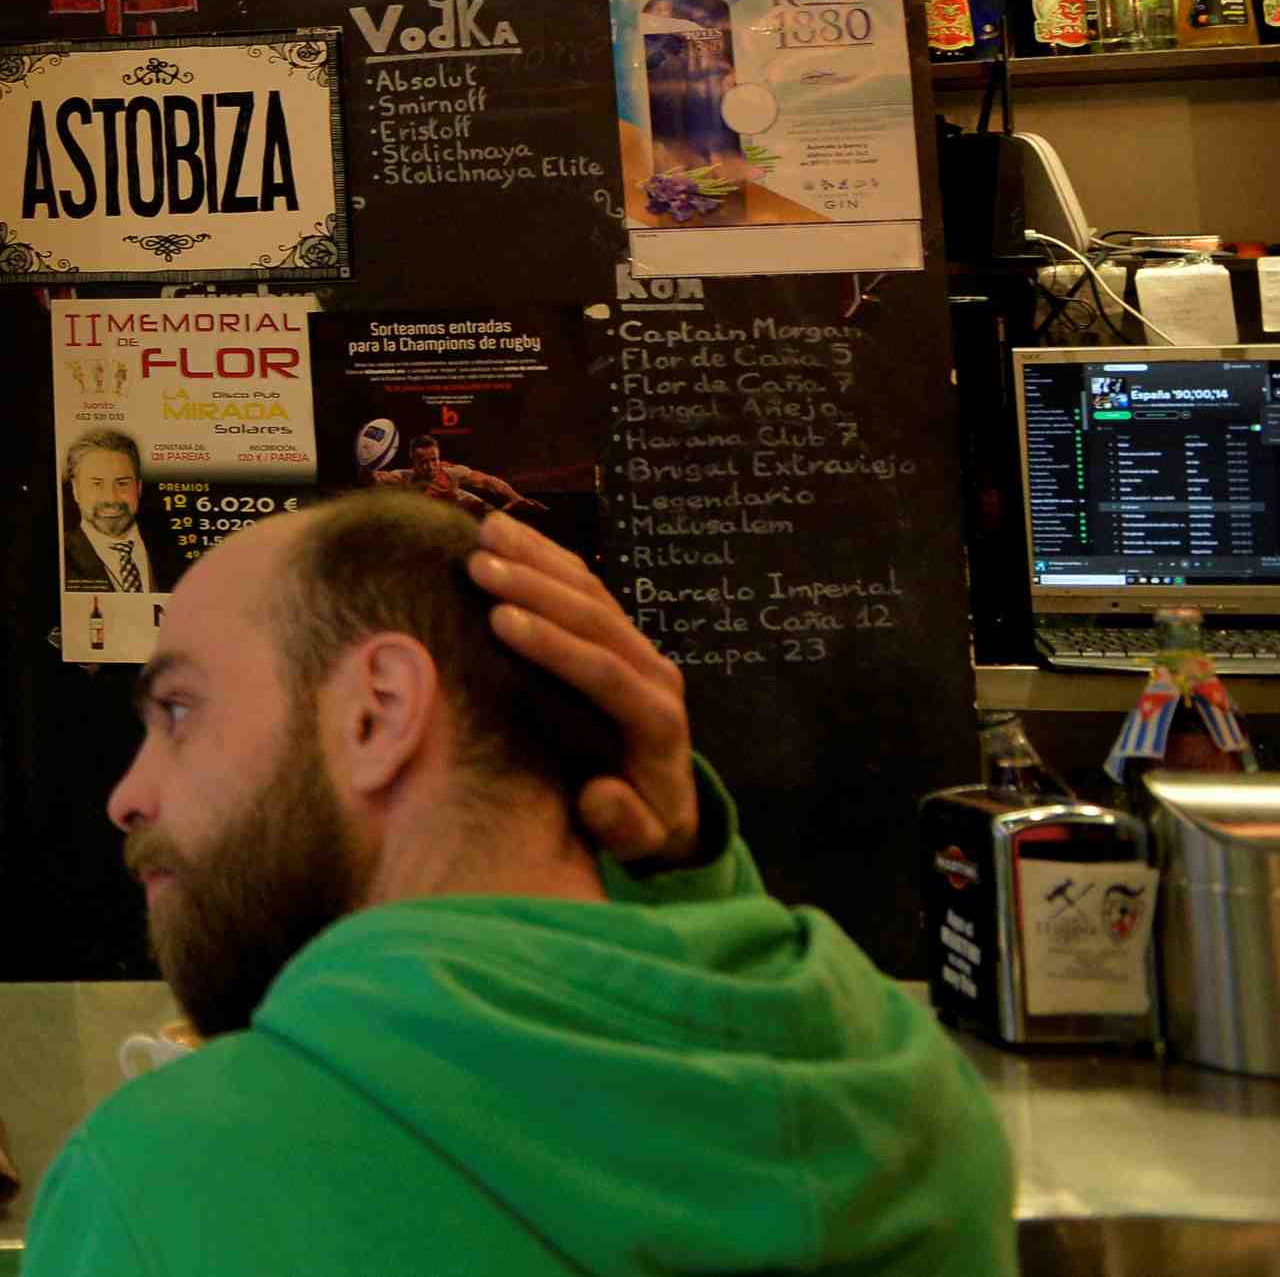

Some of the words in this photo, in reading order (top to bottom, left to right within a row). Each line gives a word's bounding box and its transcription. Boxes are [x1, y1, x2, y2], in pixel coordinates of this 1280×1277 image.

[773, 7, 873, 49] 1880
[376, 64, 478, 92] Absolut
[379, 86, 488, 117] Smirnoff
[380, 113, 473, 143] Eristoff
[21, 90, 299, 220] ASTOBIZA
[382, 142, 535, 166] Stolichnaya
[383, 165, 537, 189] Stolichnaya
[542, 156, 605, 177] Elite
[64, 313, 103, 347] II
[107, 313, 301, 333] MEMORIAL
[117, 337, 139, 347] DE
[370, 321, 446, 337] Sorteamos
[449, 319, 513, 334] entradas
[618, 320, 748, 347] Captain
[752, 317, 863, 343] Morgan
[348, 340, 380, 356] para
[383, 338, 397, 352] la
[399, 336, 477, 353] Champions
[479, 335, 497, 350] de
[500, 334, 541, 353] rugby
[620, 348, 683, 371] Flor
[690, 349, 728, 368] de
[733, 345, 826, 368] Caña
[141, 347, 301, 380] FLOR
[252, 390, 281, 399] Pub
[622, 373, 687, 395] Flor
[692, 374, 730, 394] de
[736, 373, 827, 395] Caña
[162, 401, 290, 421] MIRADA
[214, 423, 293, 435] Solares
[625, 428, 744, 450] Havana
[758, 425, 827, 448] Club
[627, 456, 740, 483] Brugal
[752, 451, 917, 480] Extraviejo
[158, 483, 210, 493] PREMIOS
[631, 482, 816, 511] Legendario
[196, 496, 275, 514] 6.020
[631, 509, 794, 537] Matusalem
[632, 540, 736, 569] Ritual
[634, 575, 756, 604] Barcelo
[767, 568, 904, 605] Imperial
[637, 608, 699, 633] Flor
[714, 608, 750, 633] de
[759, 605, 845, 632] Caña
[855, 604, 894, 629] 12
[783, 638, 827, 662] 23
